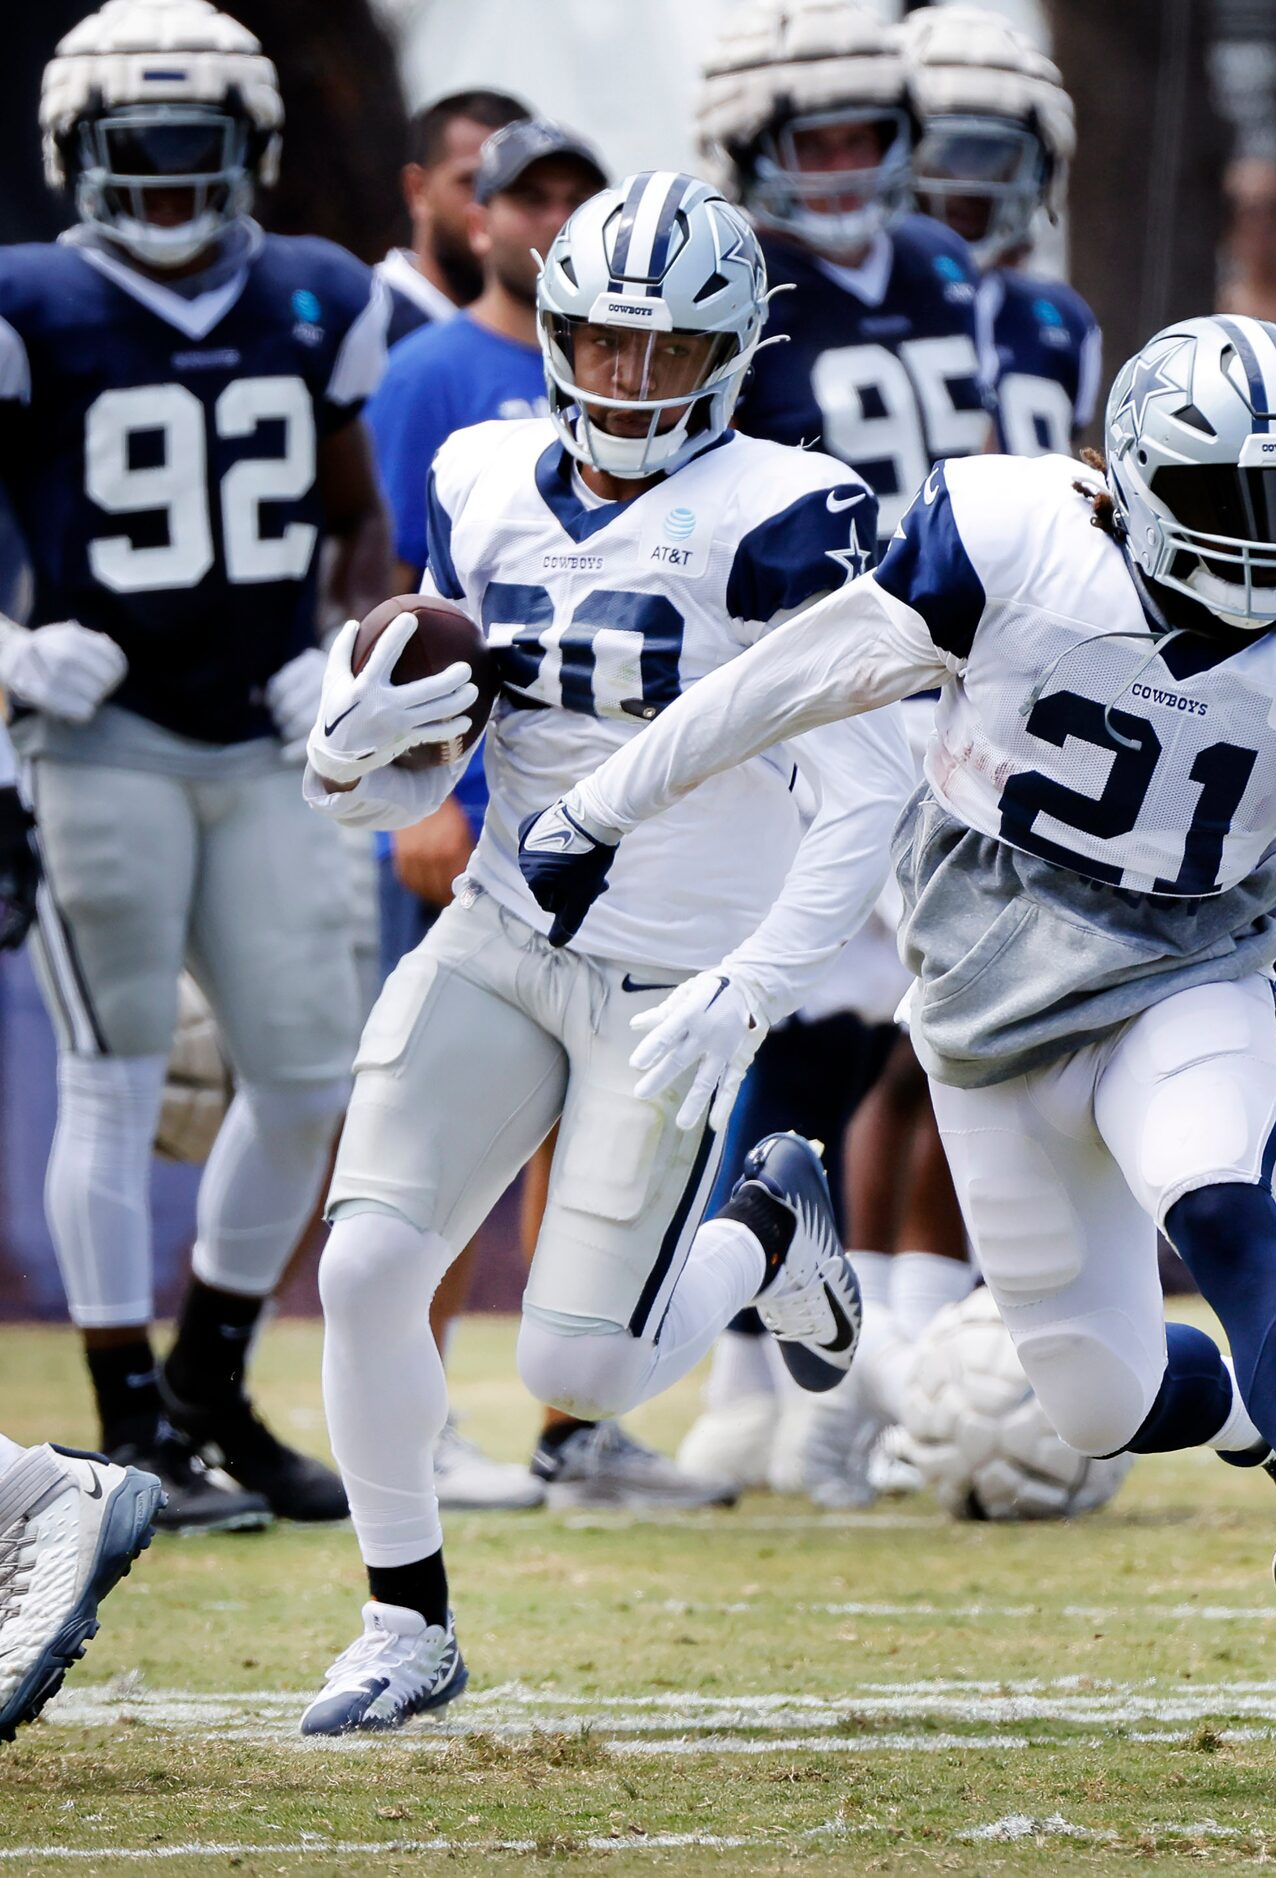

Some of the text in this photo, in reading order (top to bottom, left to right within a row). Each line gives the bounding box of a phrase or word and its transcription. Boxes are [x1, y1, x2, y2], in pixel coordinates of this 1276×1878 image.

[608, 304, 653, 316] COWBOYS
[811, 335, 991, 538] 95
[84, 374, 318, 593] 92
[543, 556, 604, 569] COWBOYS
[651, 545, 694, 566] AT&T
[1131, 682, 1208, 716] COWBOYS
[998, 689, 1258, 895] 21
